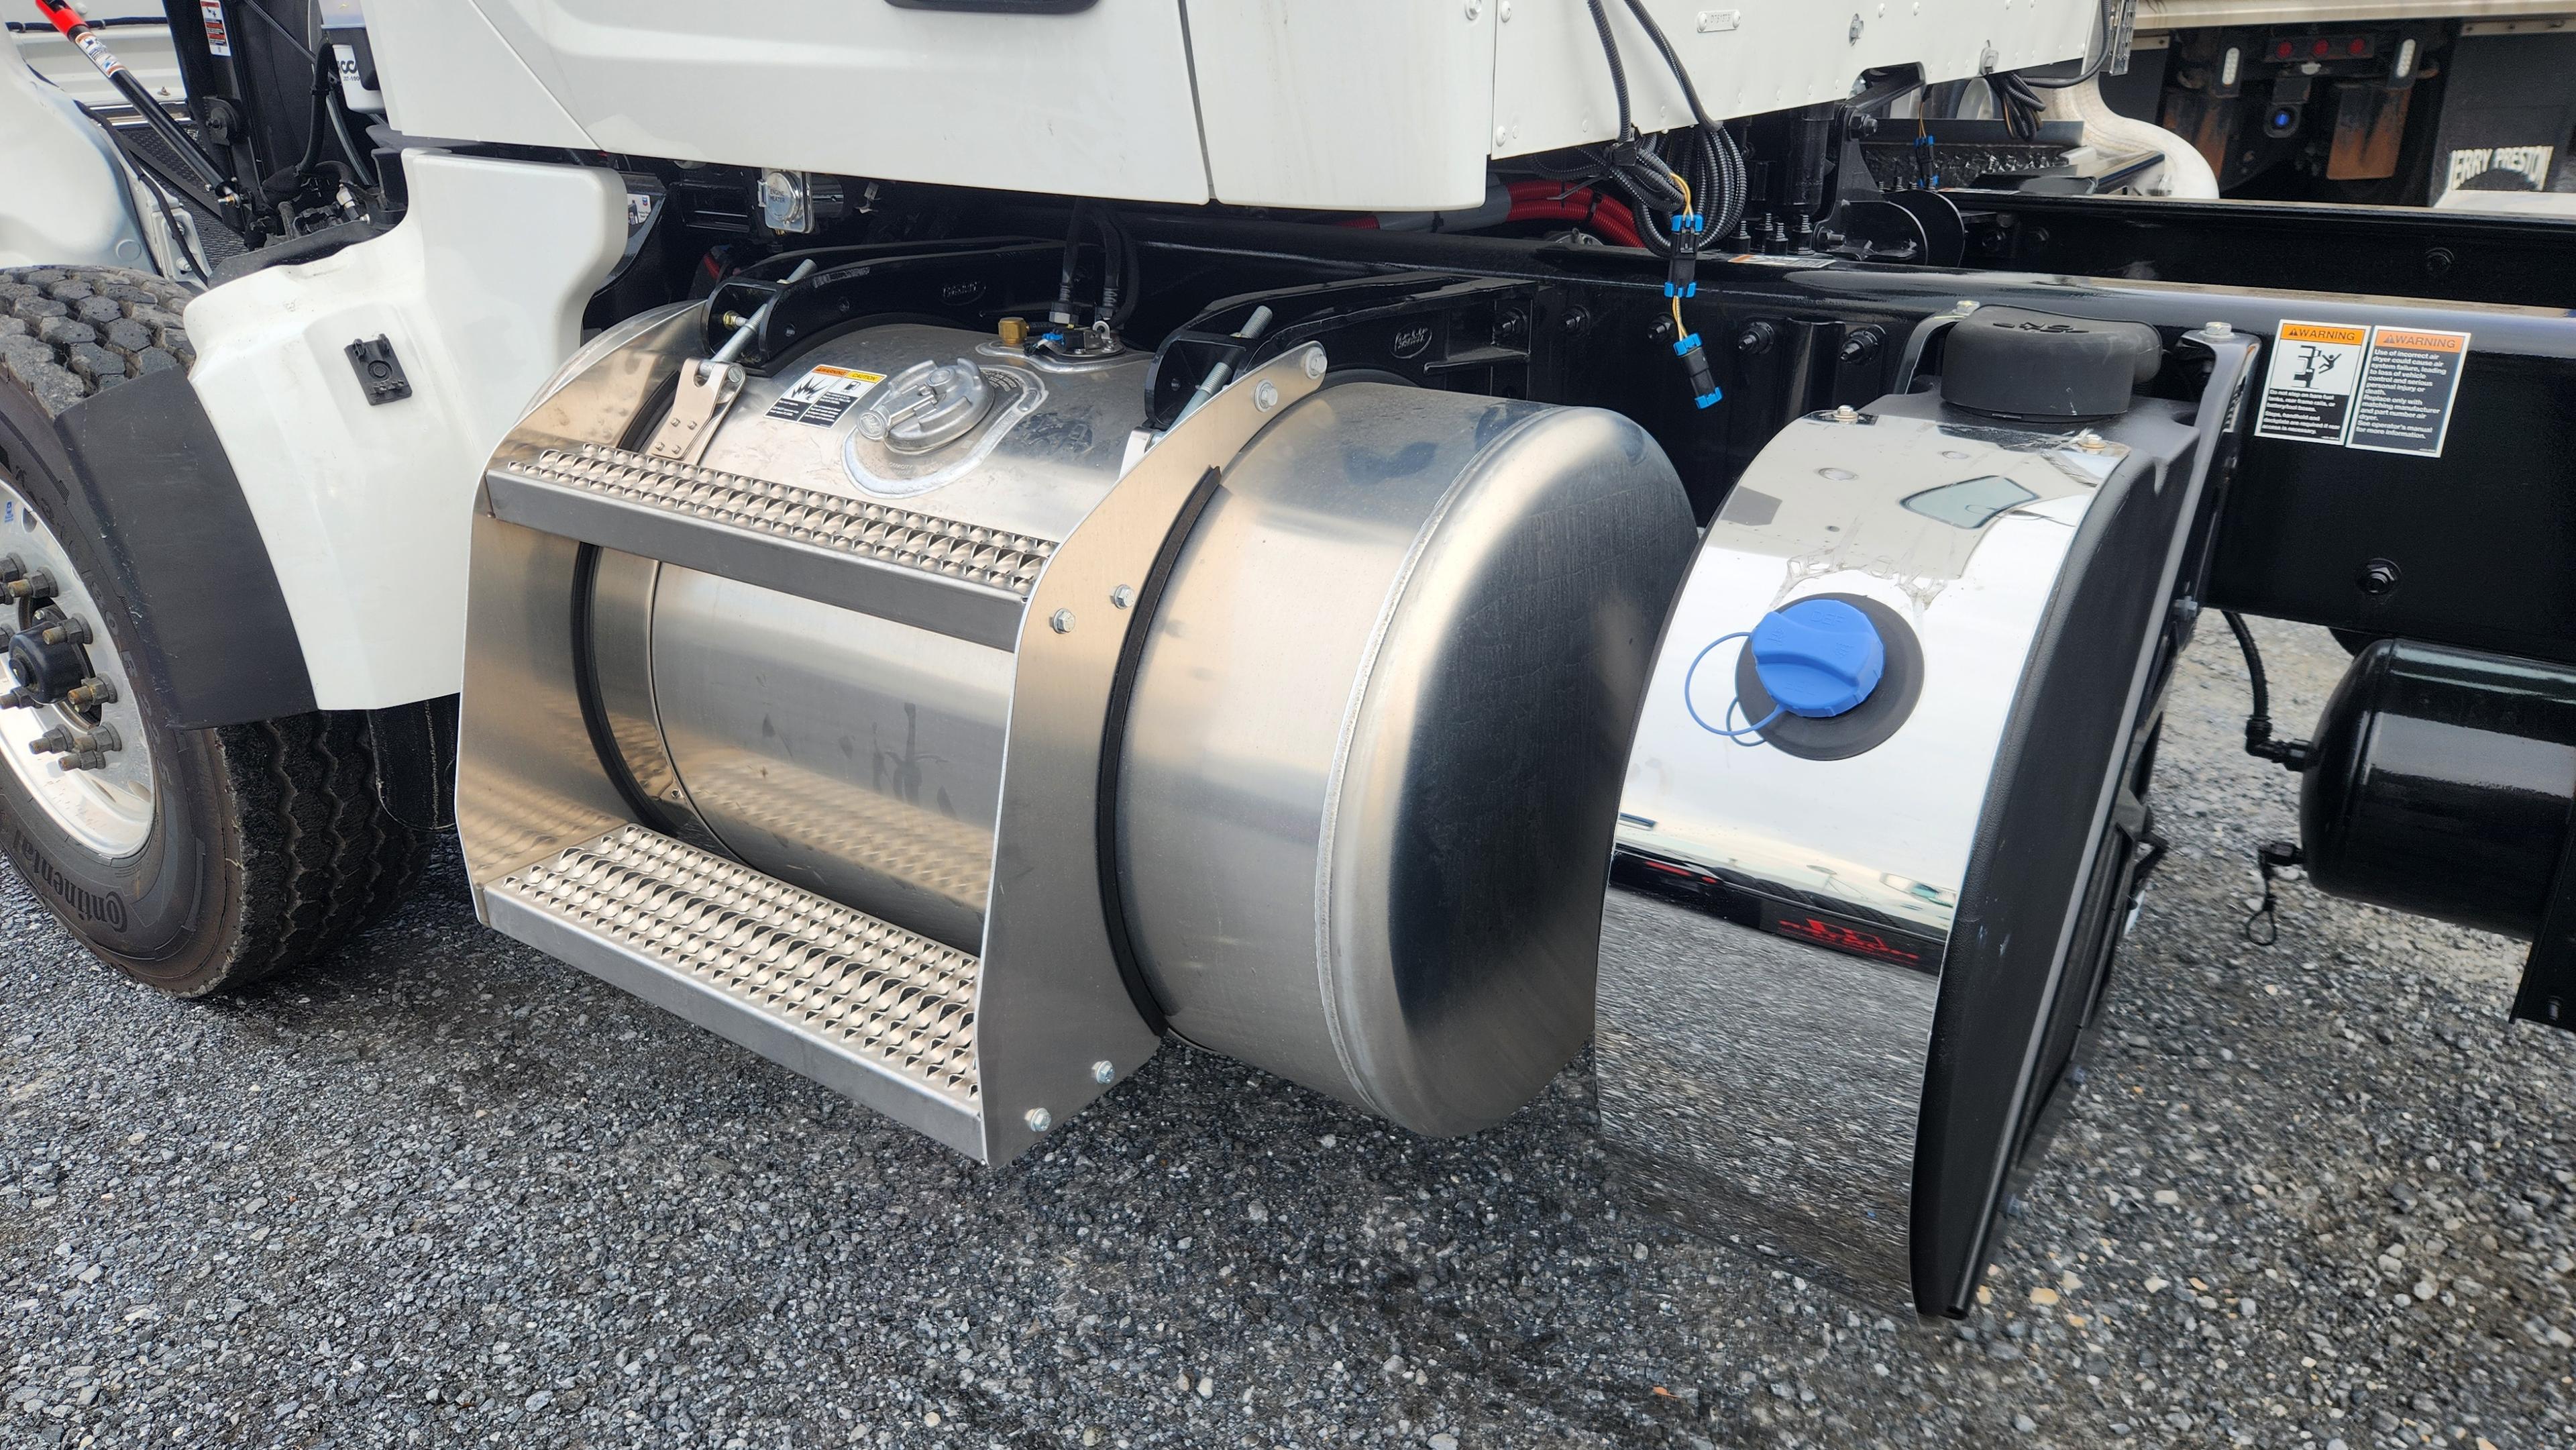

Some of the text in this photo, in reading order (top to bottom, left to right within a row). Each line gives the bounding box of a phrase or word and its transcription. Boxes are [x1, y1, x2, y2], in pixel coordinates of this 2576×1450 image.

[2493, 145, 2554, 191] PRESTON
[2298, 328, 2355, 341] WARNING
[2394, 335, 2456, 348] WARNING
[2371, 355, 2391, 363] dryer
[2396, 350, 2428, 359] incorrect
[2370, 362, 2396, 370] system
[2420, 367, 2447, 375] leading
[851, 373, 877, 381] CAUTION
[2401, 371, 2426, 379] vehicle
[2365, 381, 2396, 391] personal
[2396, 384, 2416, 393] injury
[2362, 394, 2392, 403] Replace
[2391, 397, 2407, 405] only
[2361, 401, 2440, 414] matching manufacturer
[2389, 410, 2416, 418] number
[2371, 421, 2406, 431] operator's
[2406, 425, 2433, 433] manual
[2385, 429, 2427, 439] information.
[1810, 610, 1846, 626] DEF
[11, 827, 128, 933] Continental
